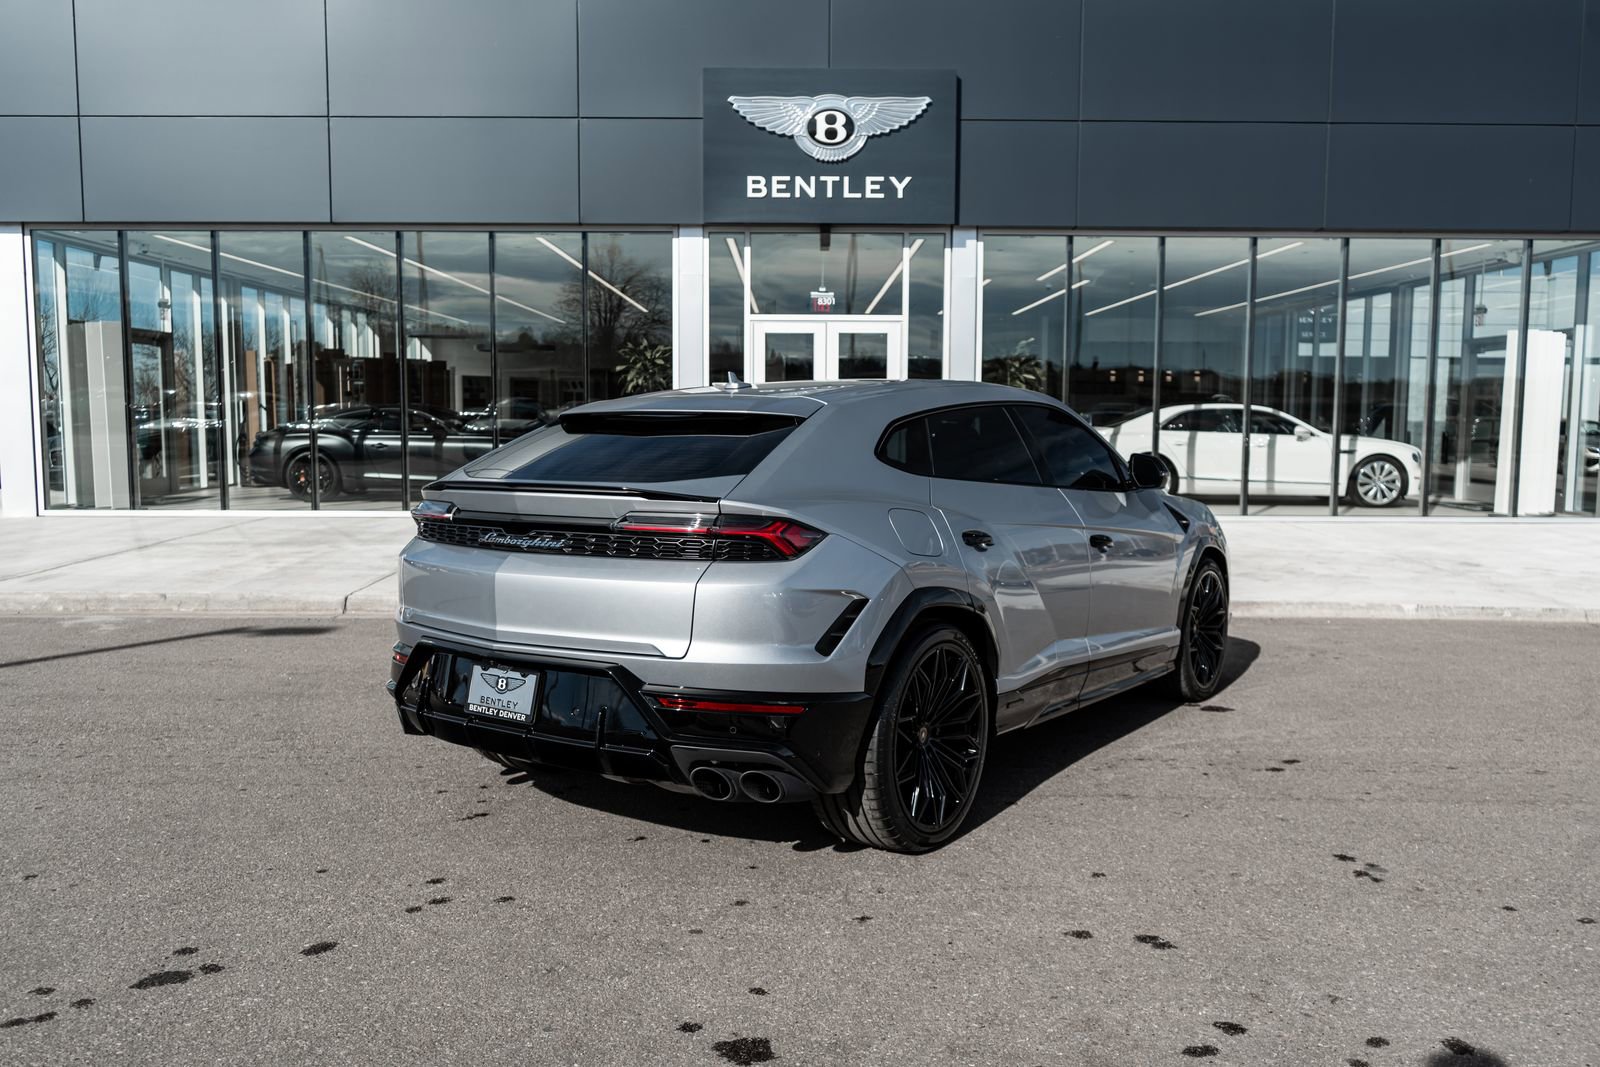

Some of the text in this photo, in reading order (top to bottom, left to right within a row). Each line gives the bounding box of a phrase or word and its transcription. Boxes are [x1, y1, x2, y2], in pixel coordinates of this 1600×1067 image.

[814, 110, 847, 144] B
[746, 175, 912, 199] BENTLEY
[817, 297, 835, 305] 8301
[478, 532, 565, 549] Lamborghini
[497, 678, 506, 690] B
[480, 695, 518, 710] BENTLEY
[468, 703, 526, 721] BENTLEY DENVER
